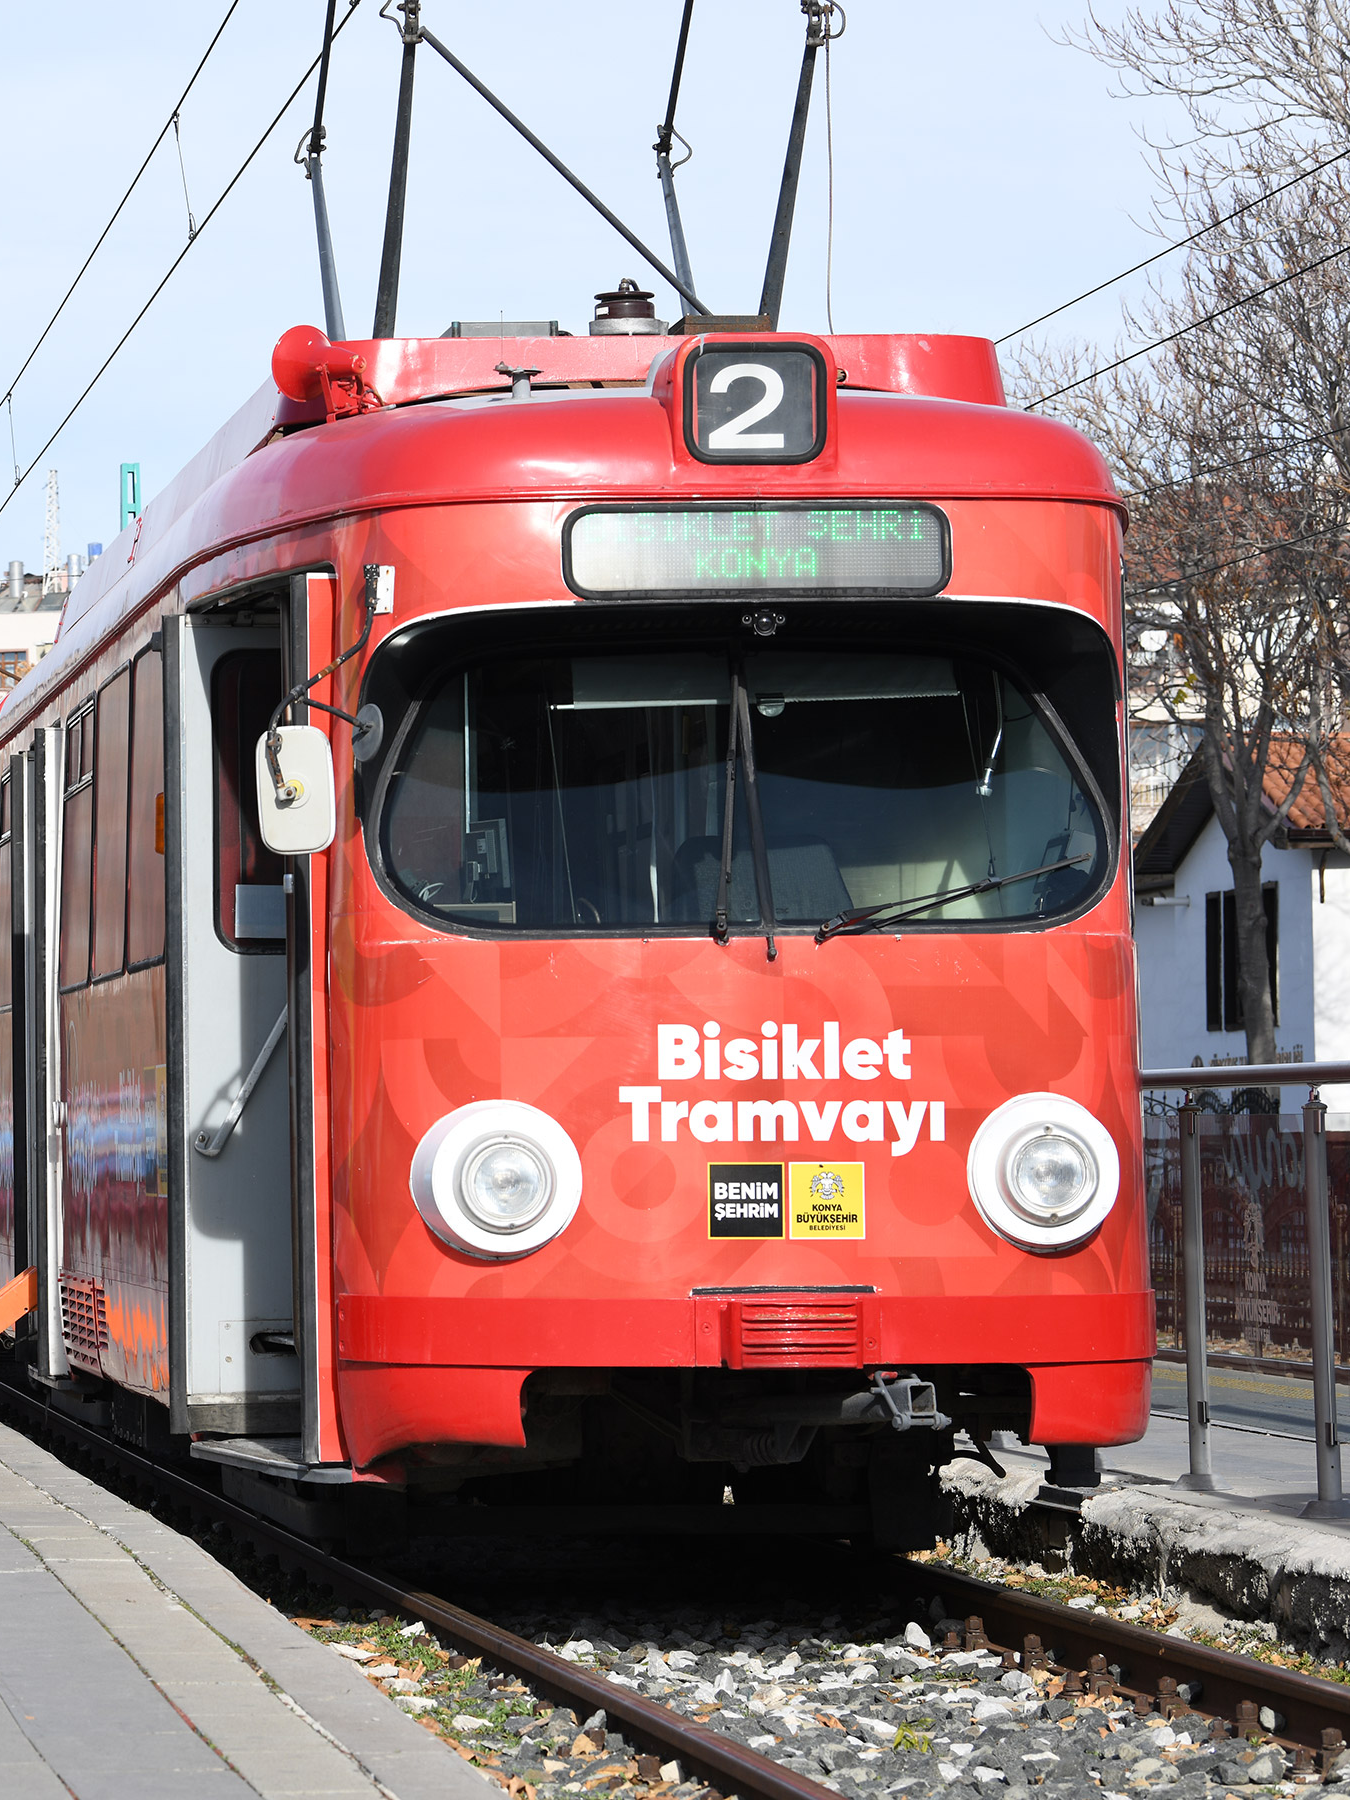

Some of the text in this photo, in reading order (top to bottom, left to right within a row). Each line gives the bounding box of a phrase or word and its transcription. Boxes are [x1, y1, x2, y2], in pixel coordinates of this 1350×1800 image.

[708, 363, 785, 449] 2
[696, 548, 816, 578] KONYA
[657, 1020, 912, 1081] Bisiklet
[618, 1085, 945, 1157] Tramvayı
[796, 1211, 858, 1225] BÜYÜKŞEHİR
[812, 1203, 843, 1212] KONYA
